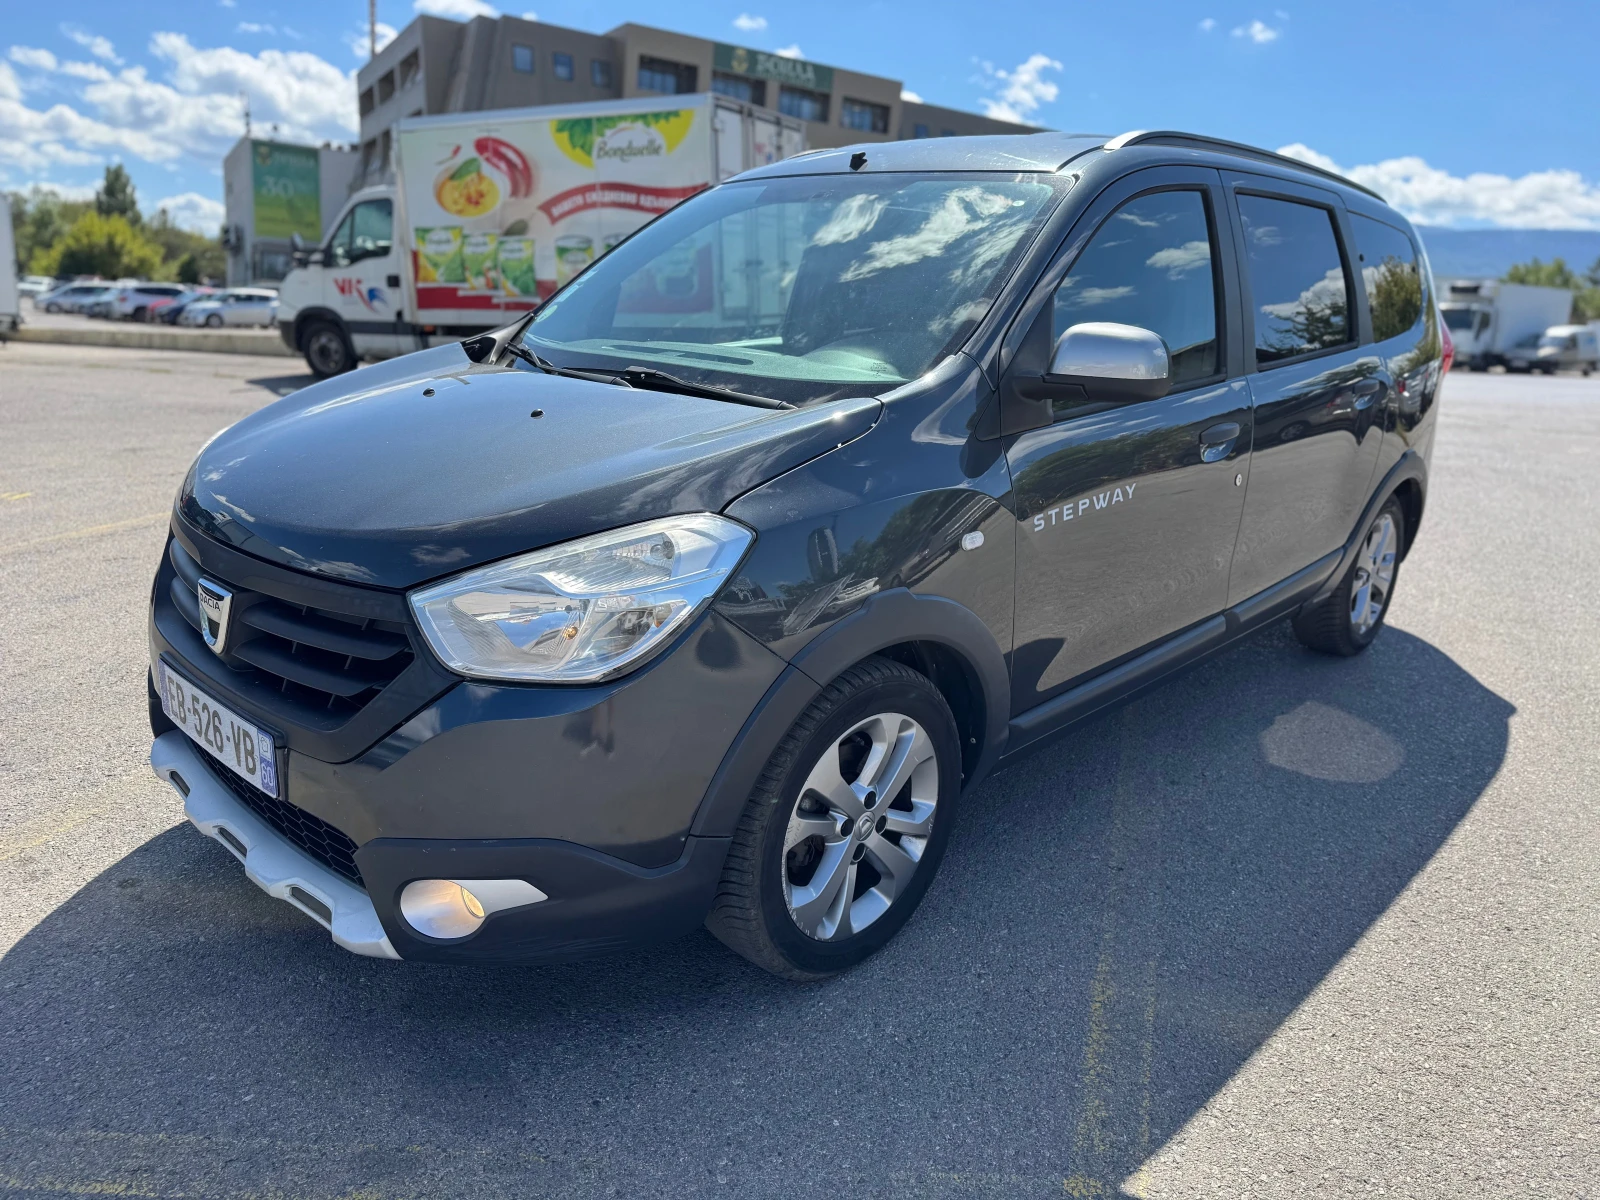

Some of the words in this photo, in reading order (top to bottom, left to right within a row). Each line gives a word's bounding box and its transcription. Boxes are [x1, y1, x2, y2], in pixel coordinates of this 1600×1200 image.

[597, 139, 663, 163] Bonduelle
[1033, 482, 1137, 532] STEPWAY
[199, 592, 221, 611] DACIA
[167, 674, 257, 776] EB-526-VB
